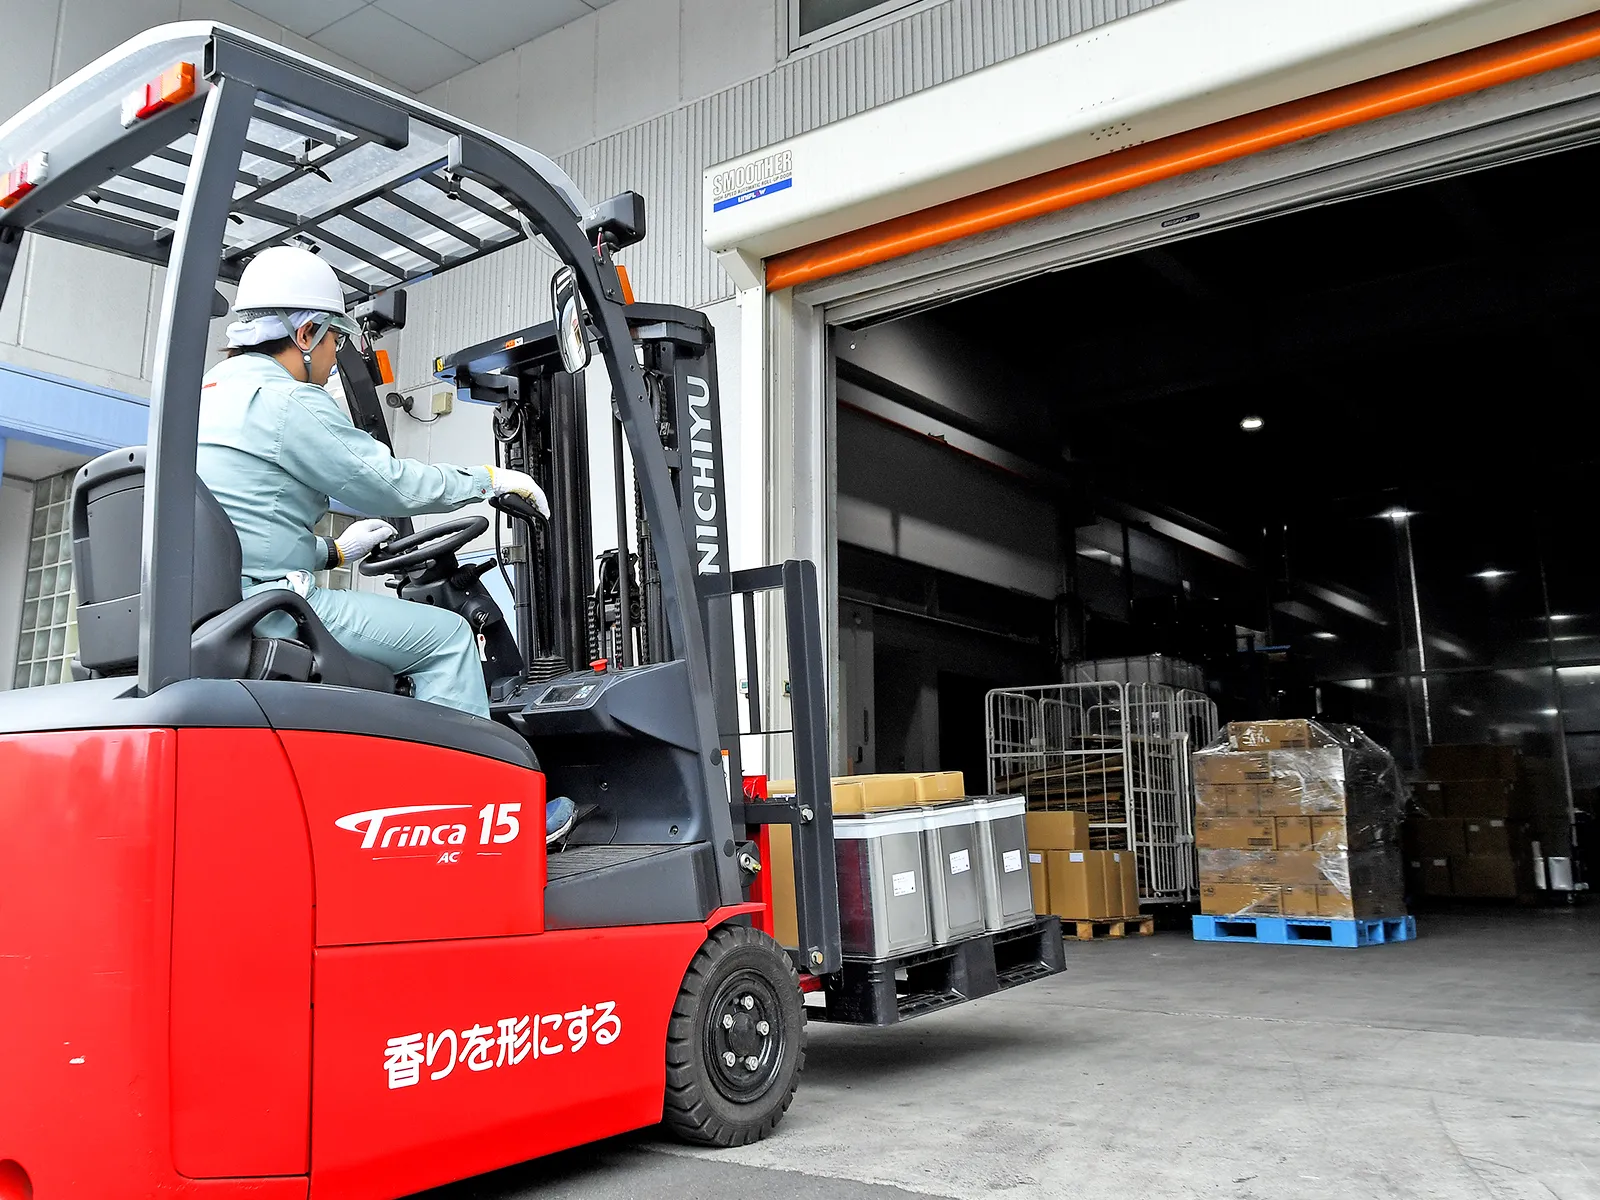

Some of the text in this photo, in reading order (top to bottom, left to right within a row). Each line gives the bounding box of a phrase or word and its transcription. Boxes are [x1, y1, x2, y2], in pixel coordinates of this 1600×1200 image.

[713, 149, 792, 196] SMOOTHER
[724, 191, 737, 199] SPEED
[780, 172, 792, 180] DOOR
[686, 375, 721, 576] NICHIYU
[334, 802, 522, 849] Trinca 15
[437, 851, 461, 864] AC
[383, 1000, 623, 1090] 香りを形にする
